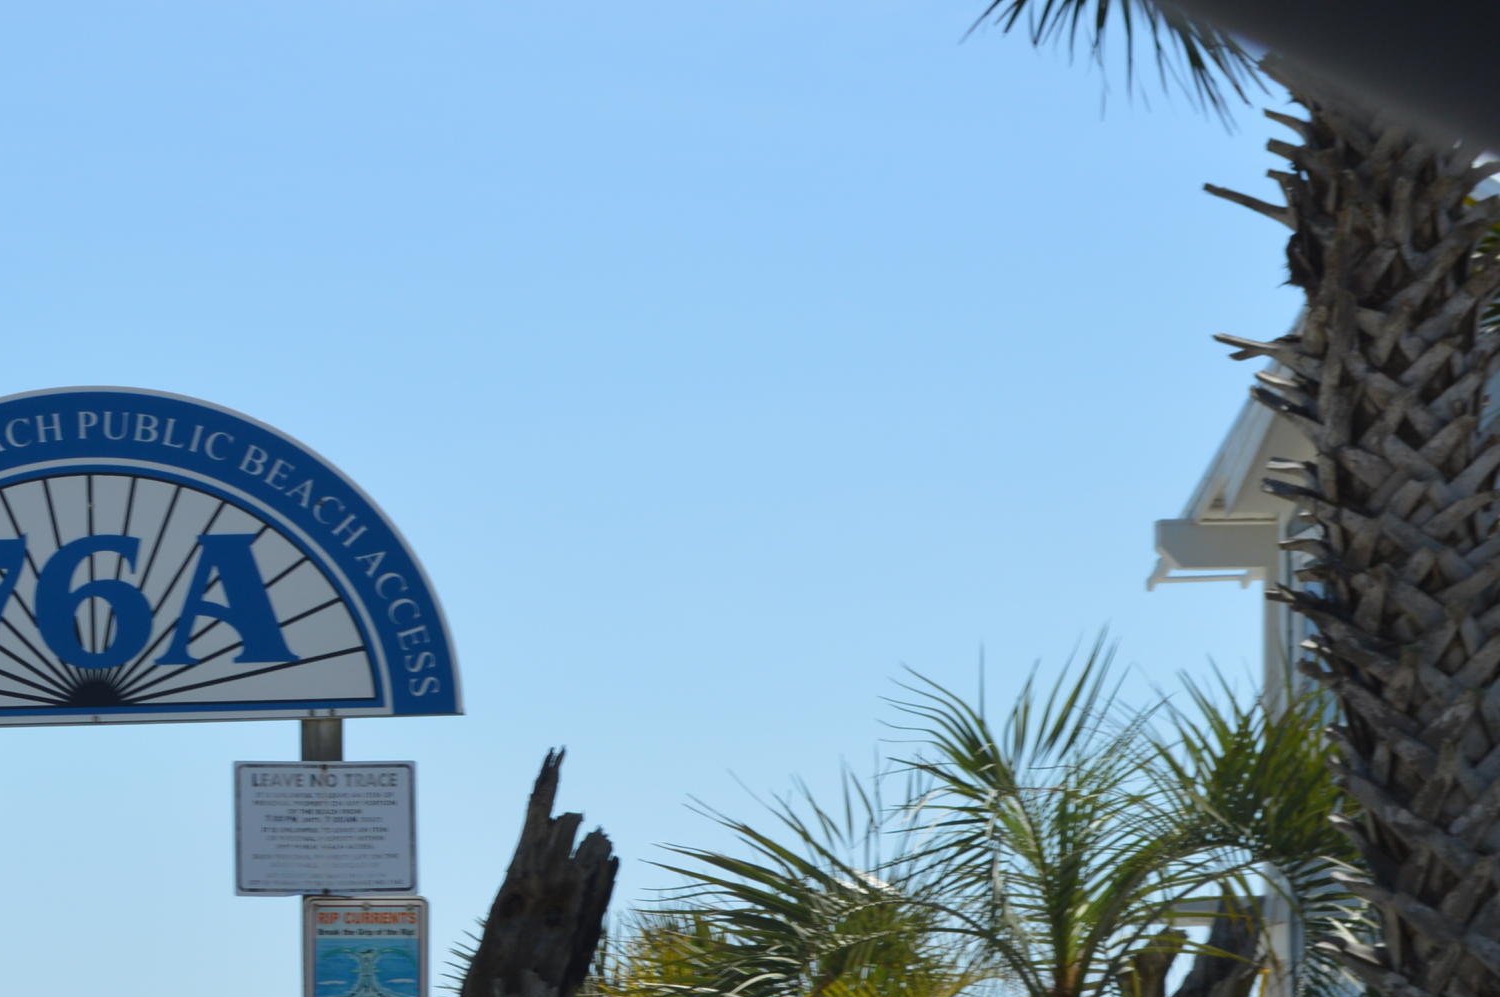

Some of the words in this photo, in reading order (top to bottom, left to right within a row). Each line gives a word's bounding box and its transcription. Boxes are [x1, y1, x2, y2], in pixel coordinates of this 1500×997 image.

[77, 411, 235, 461] PUBLIC
[238, 444, 368, 547] BEACH
[355, 550, 440, 697] ACCESS
[252, 773, 305, 788] LEAVE
[309, 773, 338, 788] NO
[344, 773, 398, 788] TRACE
[318, 912, 340, 924] RIP
[343, 912, 418, 924] CURRENTS
